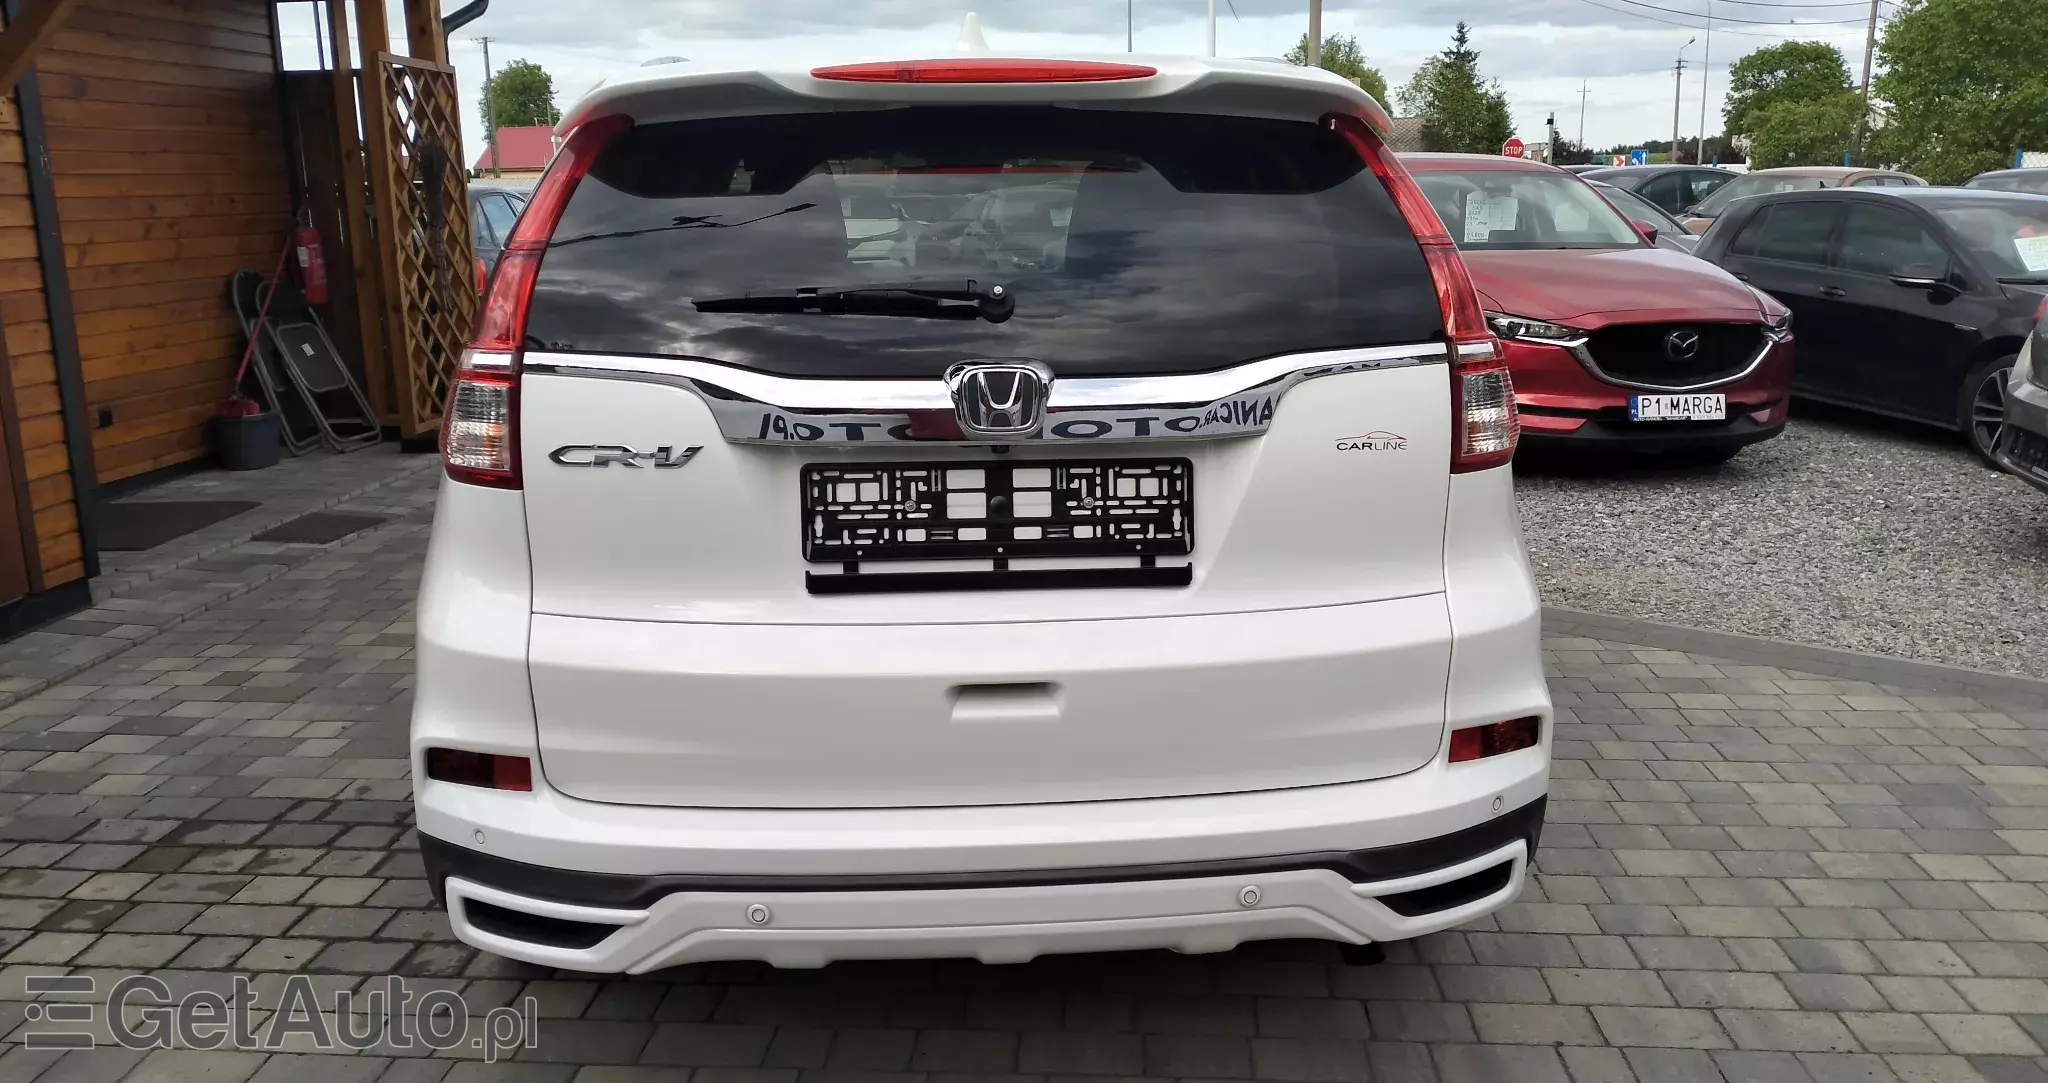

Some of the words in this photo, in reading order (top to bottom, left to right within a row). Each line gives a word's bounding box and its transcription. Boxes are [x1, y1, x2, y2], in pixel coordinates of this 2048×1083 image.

[1504, 146, 1523, 154] STOP
[1641, 397, 1661, 415] P1
[1670, 396, 1723, 415] MARGA
[548, 443, 704, 469] CR-V
